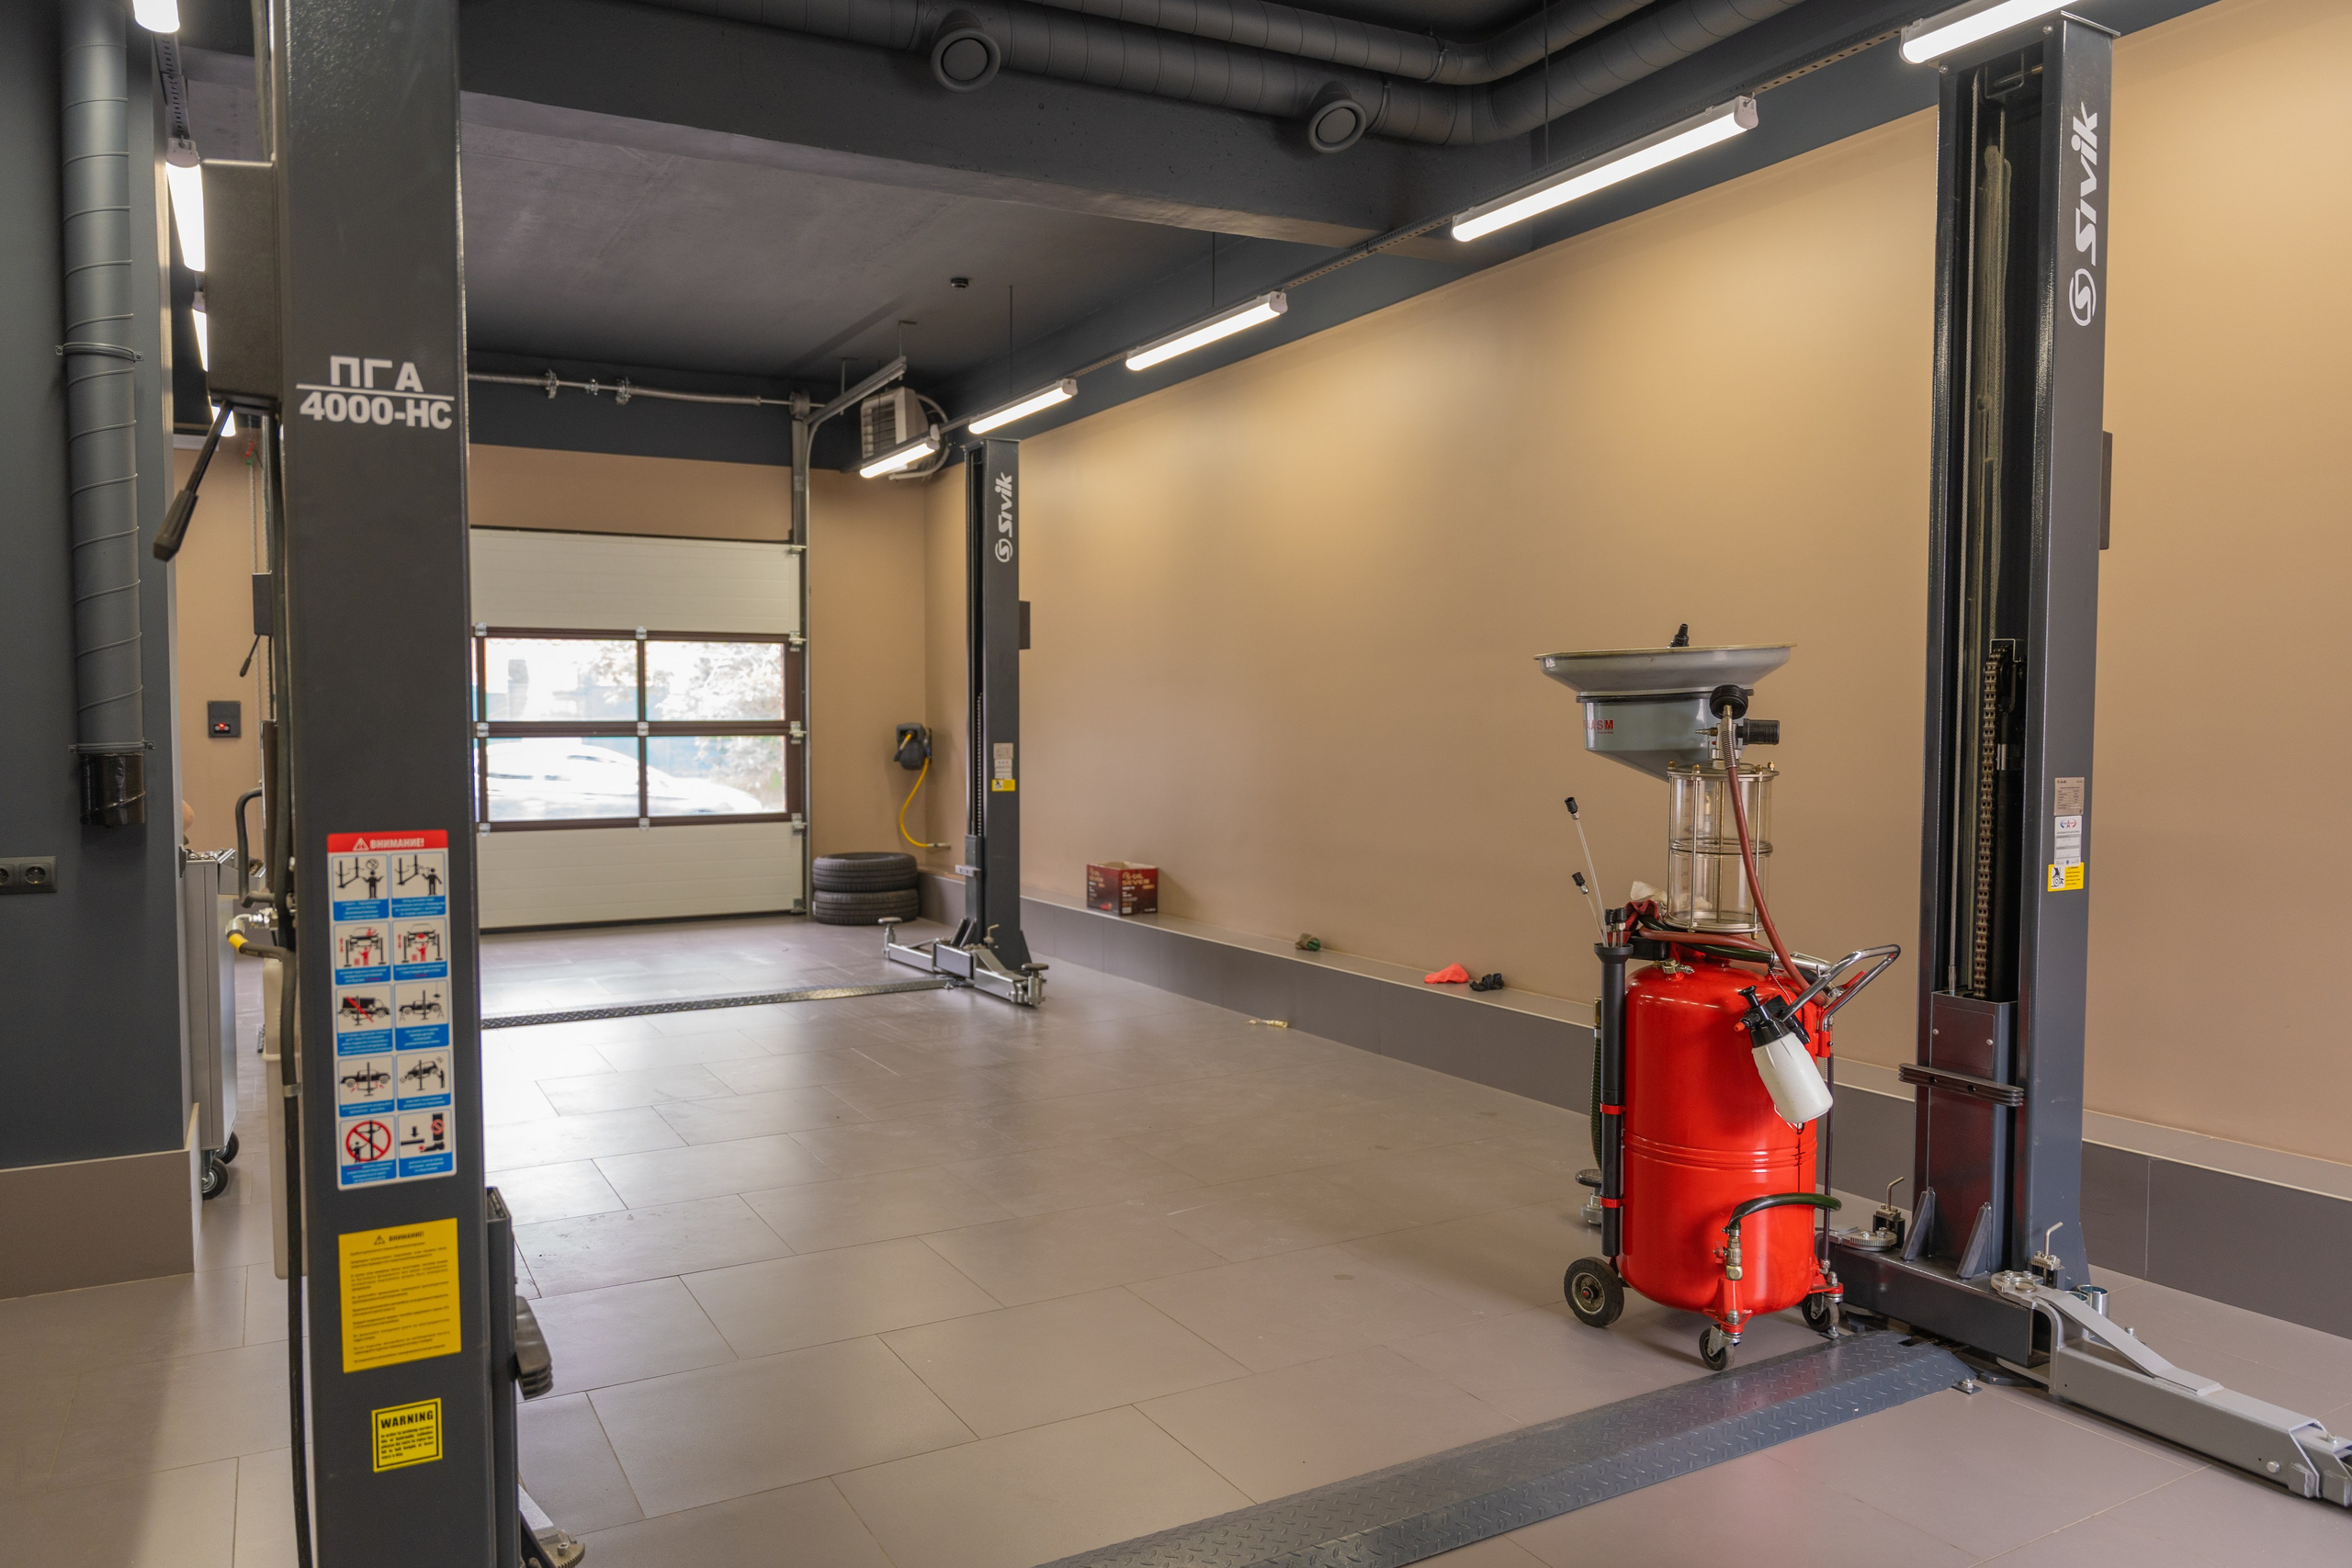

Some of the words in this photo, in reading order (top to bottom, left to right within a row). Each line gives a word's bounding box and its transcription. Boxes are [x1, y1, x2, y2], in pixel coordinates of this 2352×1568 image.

[330, 355, 424, 393] ПГА
[299, 390, 453, 430] 4000-НС
[1583, 719, 1614, 730] ASM
[369, 837, 425, 850] ВНИМАНИЕ!
[380, 1410, 434, 1429] WARNING
